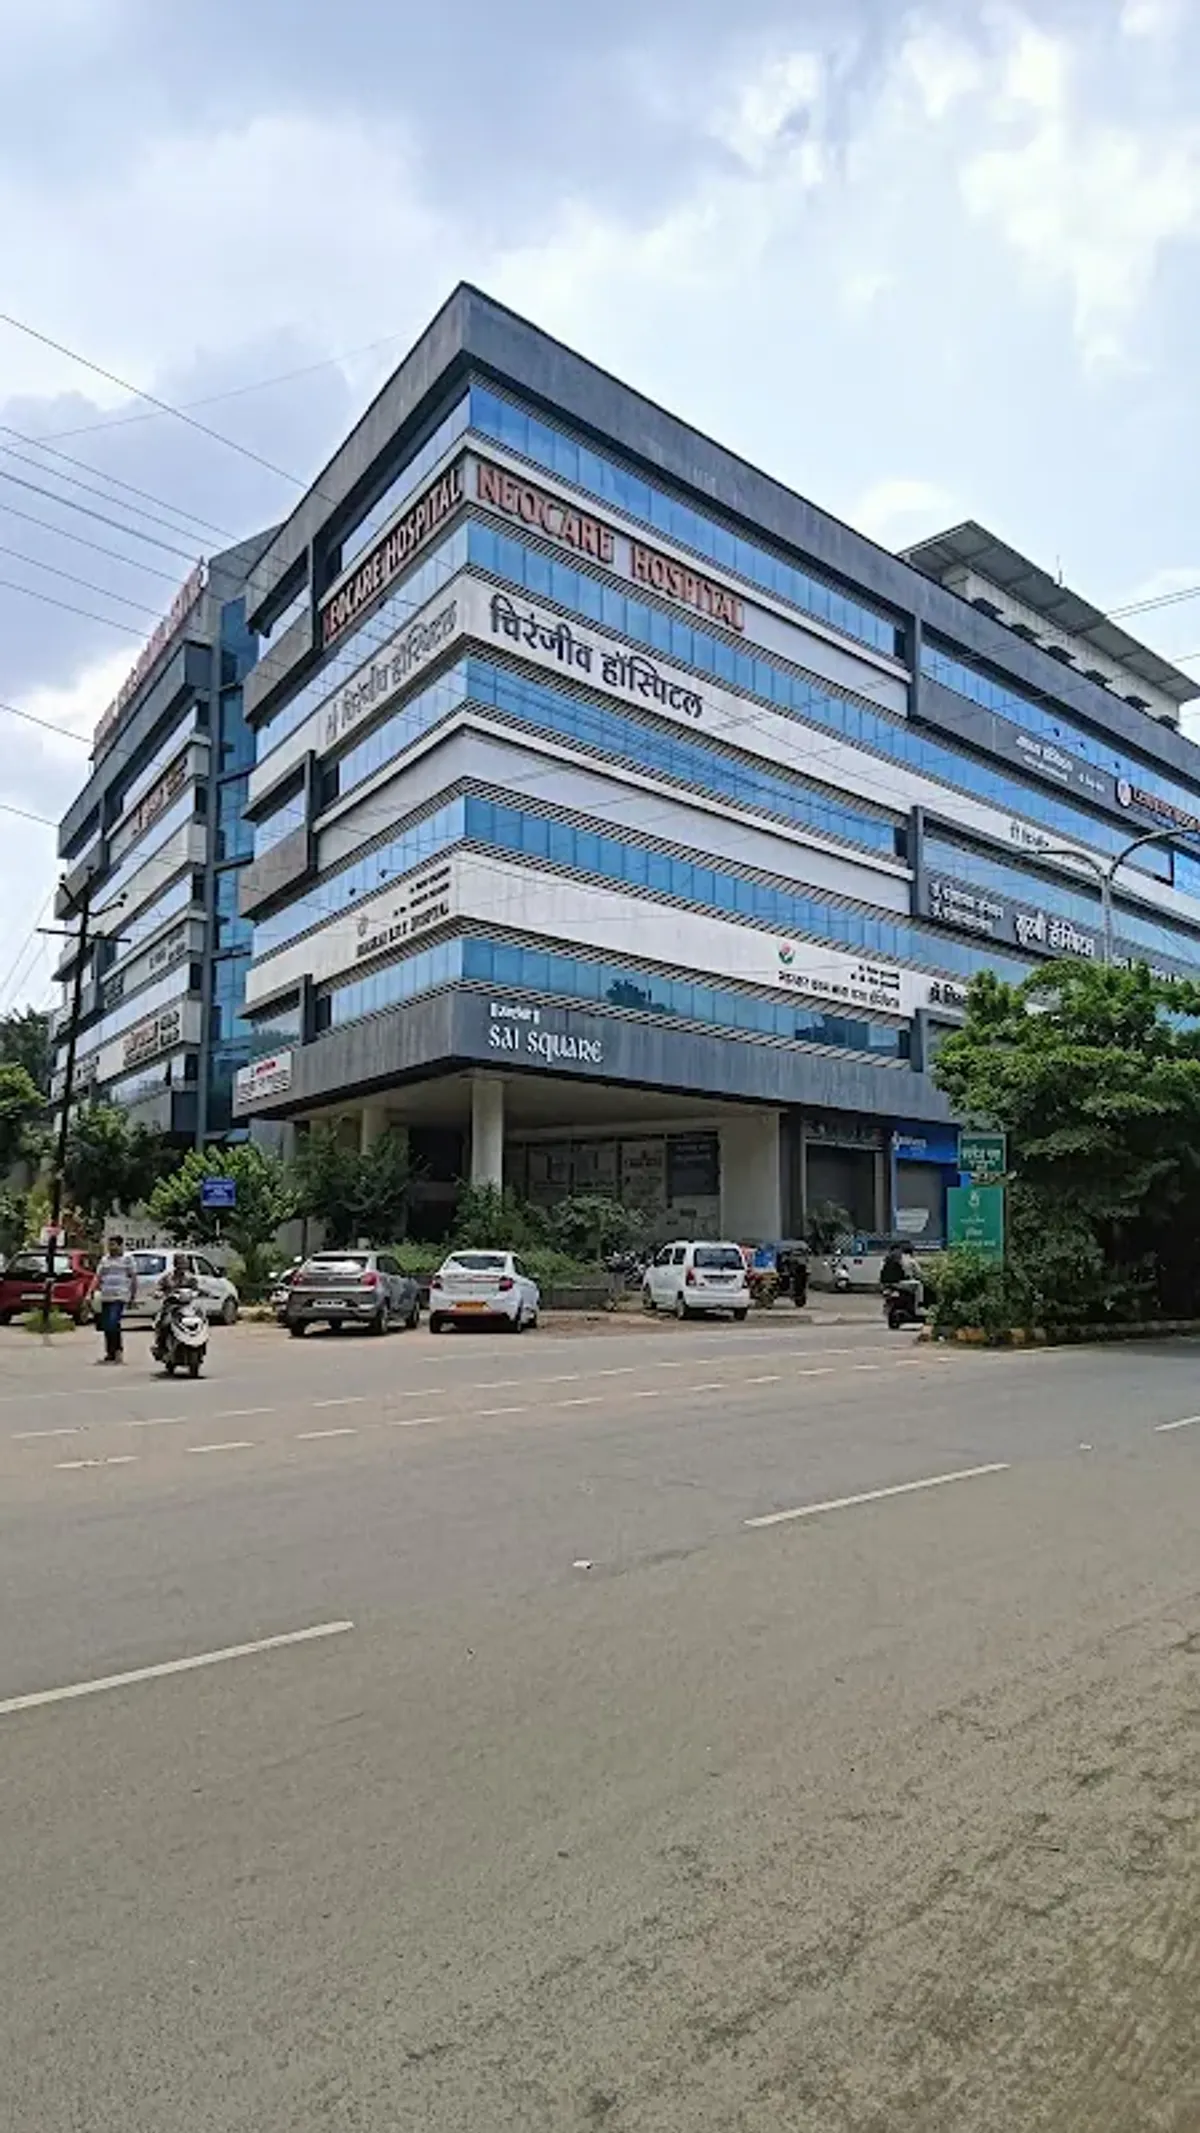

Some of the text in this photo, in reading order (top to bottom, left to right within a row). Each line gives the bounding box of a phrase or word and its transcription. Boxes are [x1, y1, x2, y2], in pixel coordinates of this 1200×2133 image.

[384, 470, 462, 576] HOSPITAL
[478, 464, 745, 633] NEOCARE HOSPITAL
[490, 595, 703, 719] चिरंजीव हॉस्पिटल
[488, 1024, 604, 1063] SAI SQUARE
